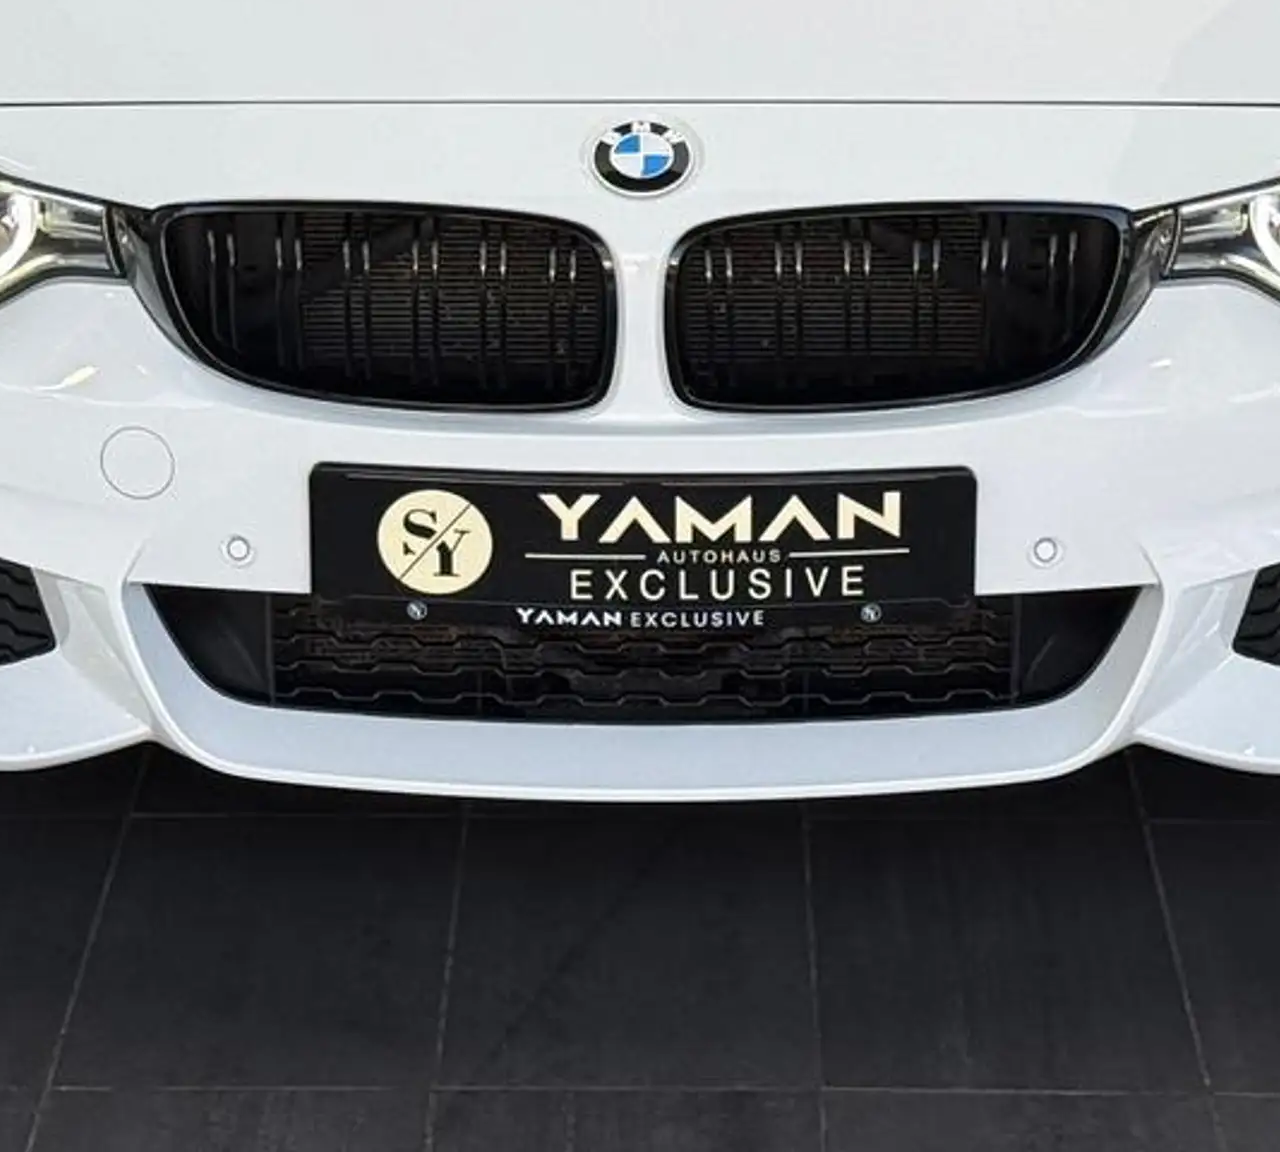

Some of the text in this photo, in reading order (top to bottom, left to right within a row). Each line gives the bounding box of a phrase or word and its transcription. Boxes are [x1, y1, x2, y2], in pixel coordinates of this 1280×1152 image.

[600, 120, 685, 146] BMW
[537, 490, 903, 544] YAMAN
[656, 549, 783, 564] AUTOHAUS
[570, 565, 865, 602] EXCLUSIVE
[516, 607, 765, 628] YAMAN EXCLUSIVE
